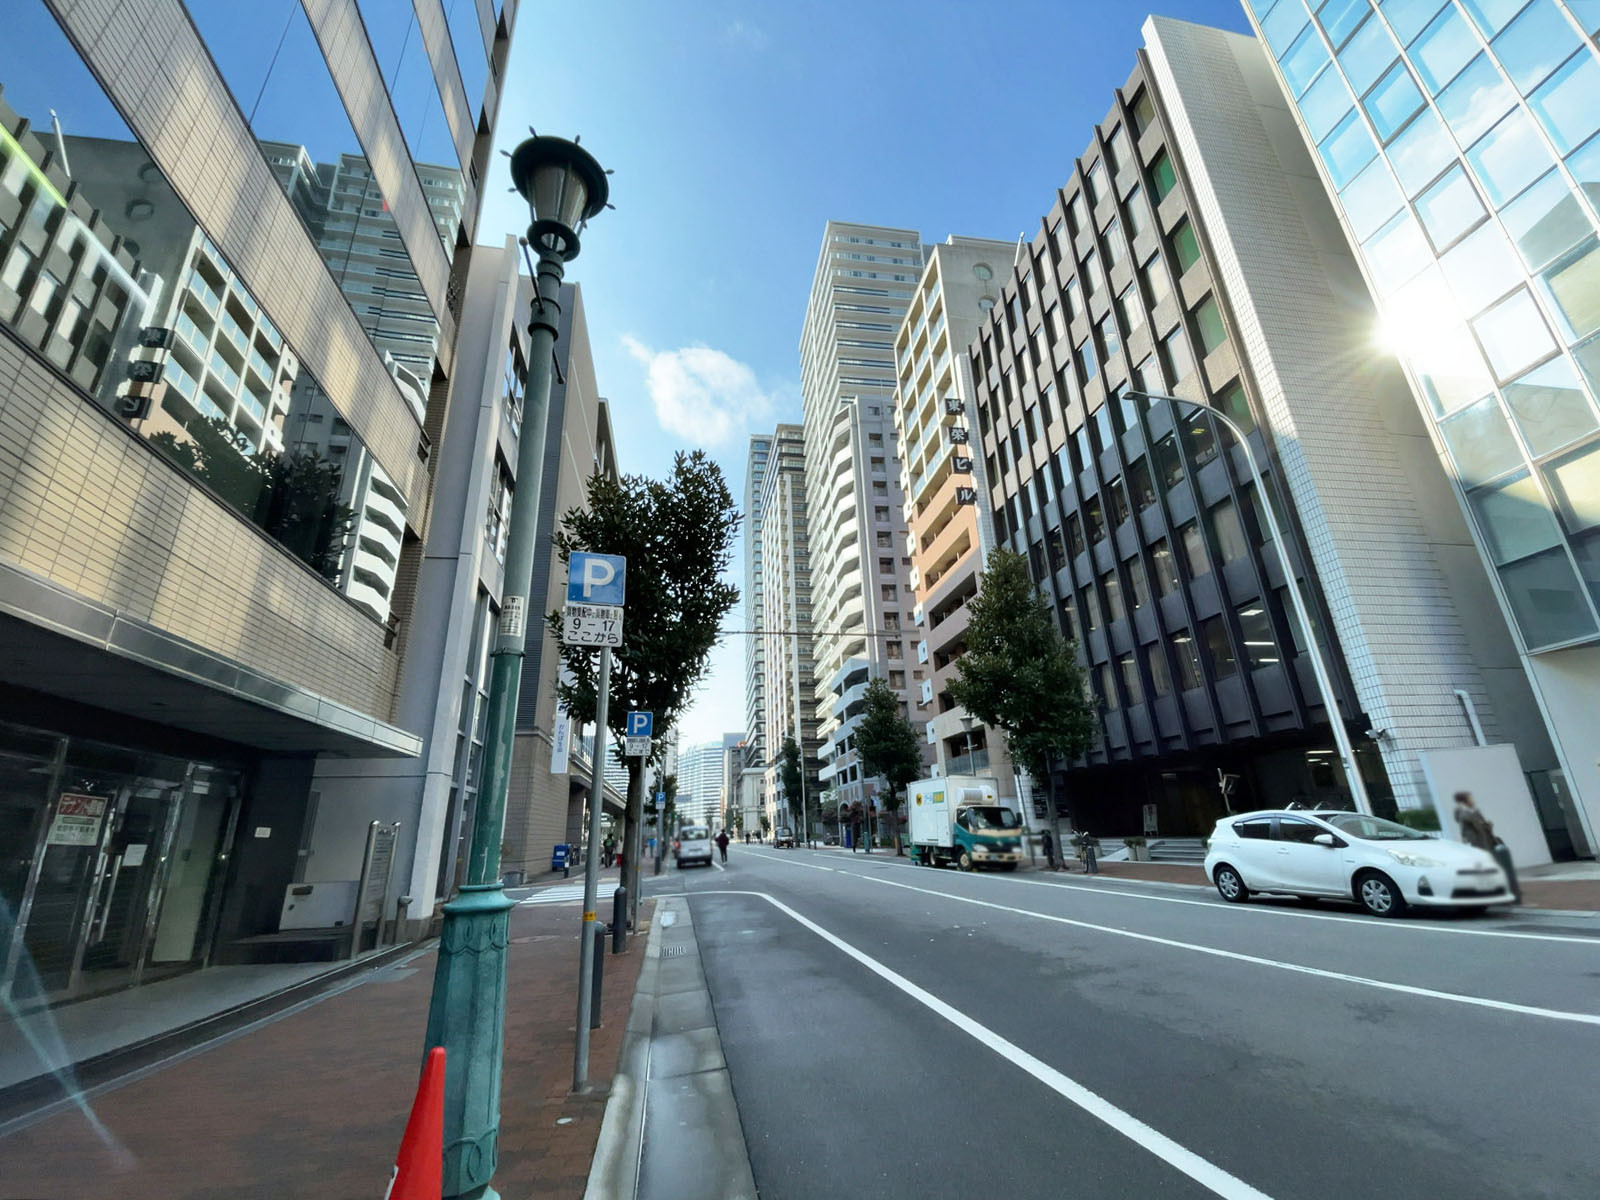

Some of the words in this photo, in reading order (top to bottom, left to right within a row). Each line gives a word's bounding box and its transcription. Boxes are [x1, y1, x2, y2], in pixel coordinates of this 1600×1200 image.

[947, 399, 972, 501] 東栄ビル
[583, 558, 615, 597] P
[573, 618, 581, 629] 9
[603, 620, 615, 632] 17
[568, 630, 618, 644] ここから
[634, 714, 648, 733] P
